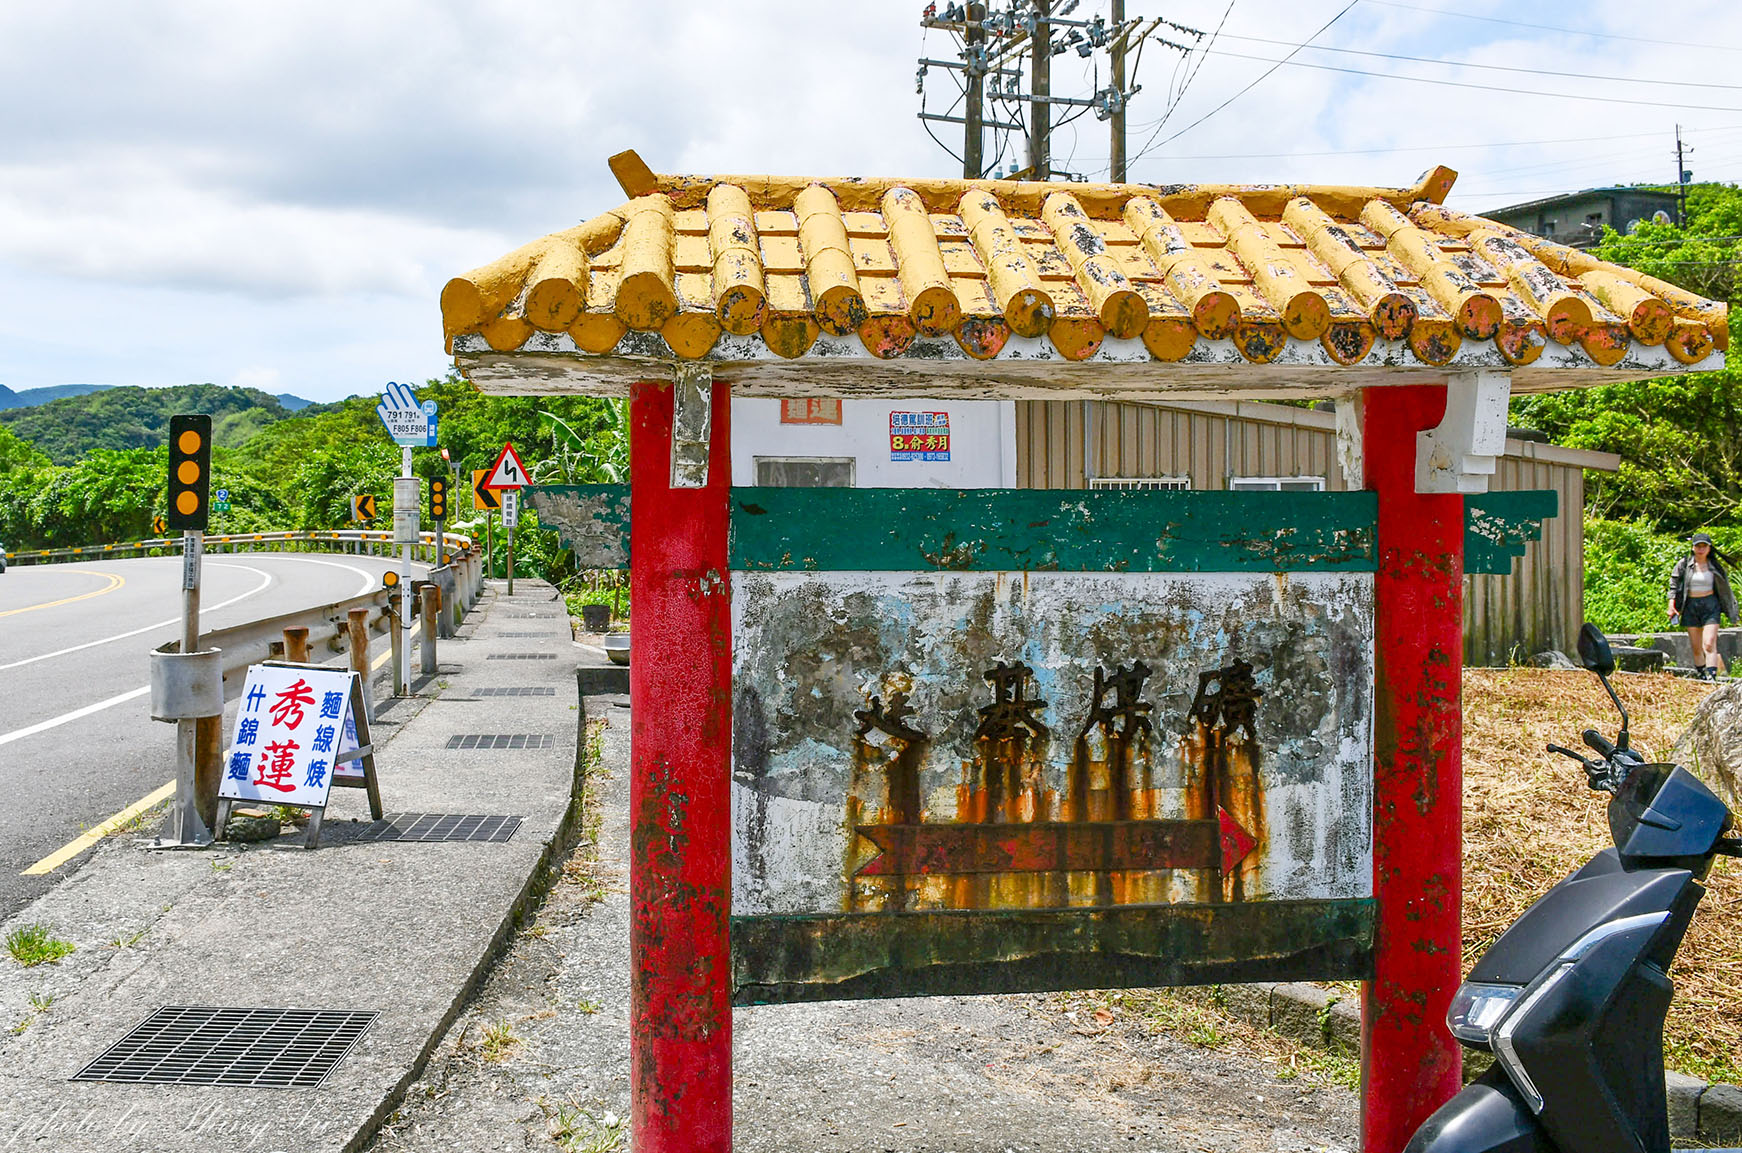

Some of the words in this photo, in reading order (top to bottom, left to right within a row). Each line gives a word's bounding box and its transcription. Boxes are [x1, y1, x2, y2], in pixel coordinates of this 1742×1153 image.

[393, 424, 410, 433] F805
[410, 424, 427, 433] F806
[228, 684, 267, 781] 什錦麵
[252, 678, 316, 793] 秀蓮
